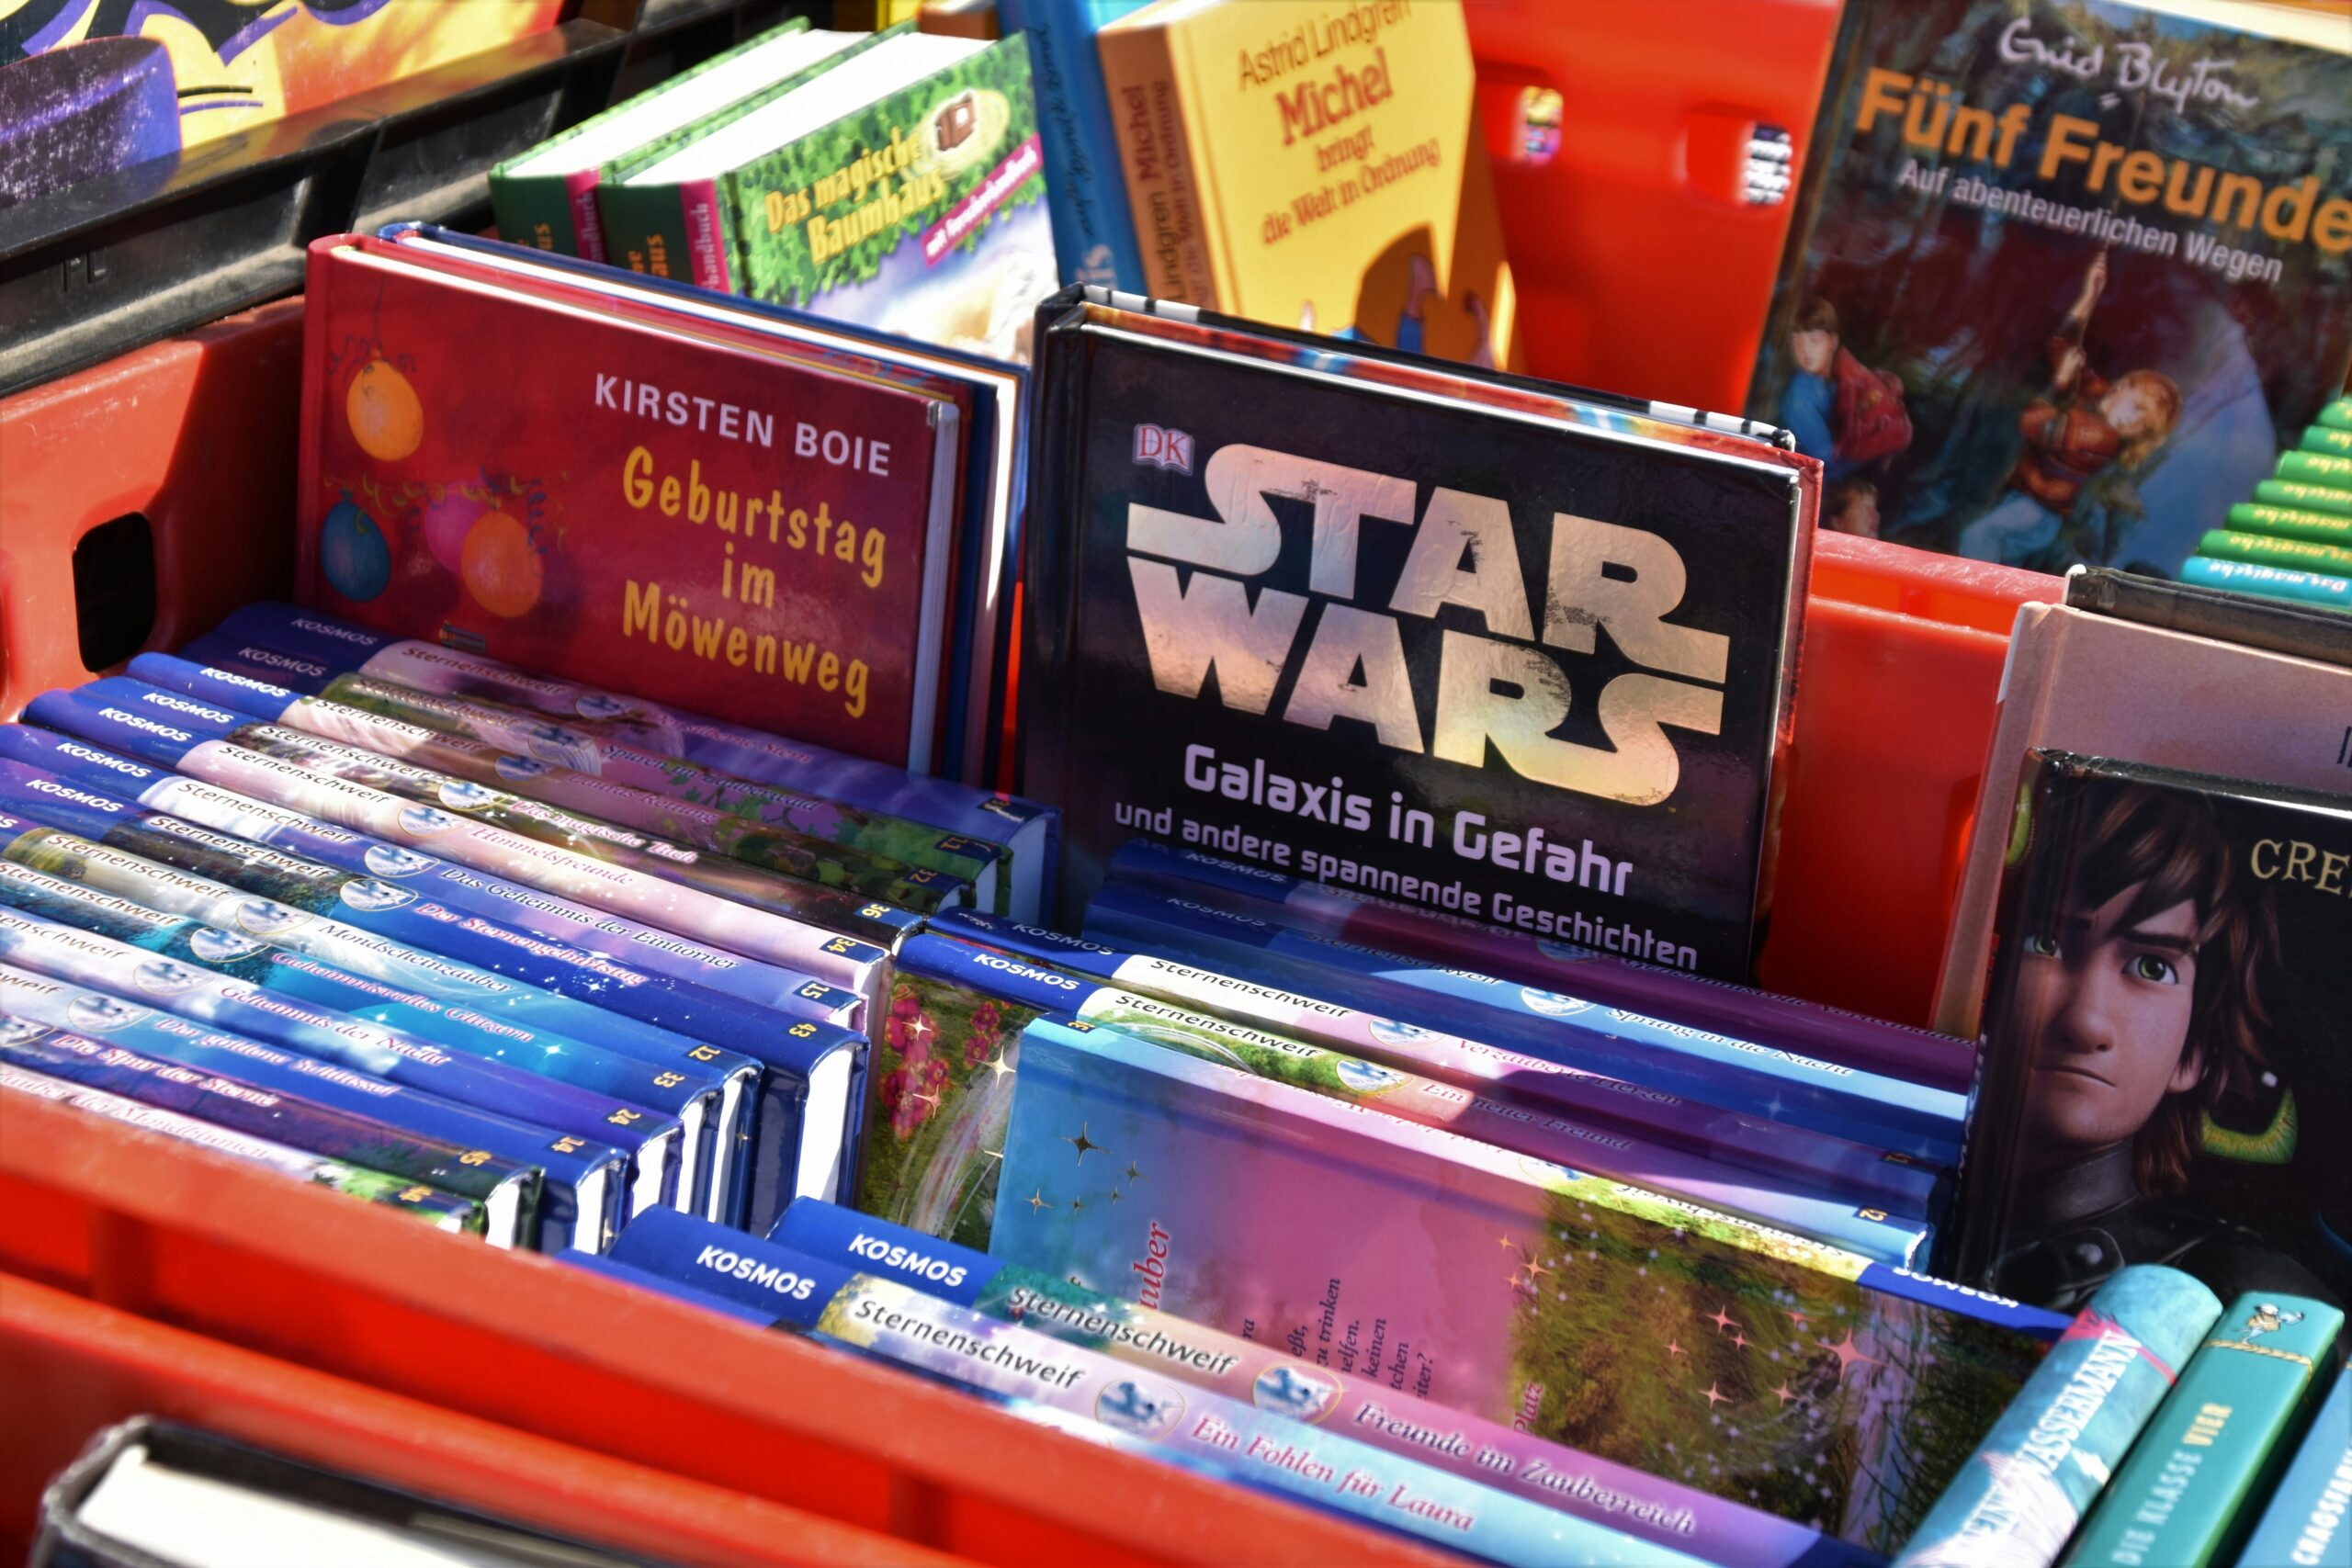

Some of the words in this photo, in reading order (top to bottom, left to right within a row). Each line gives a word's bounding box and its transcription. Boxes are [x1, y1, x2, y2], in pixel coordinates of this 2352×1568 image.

[1238, 25, 1309, 92] Astrid
[1308, 0, 1411, 57] Lindgren
[1274, 45, 1394, 147] Michel
[1999, 17, 2103, 81] Enid
[2114, 42, 2261, 113] Blyton
[764, 186, 812, 234] Das
[812, 126, 922, 209] magische
[1121, 85, 1160, 183] Michel
[1152, 80, 1180, 172] Ordnung
[1316, 124, 1375, 174] bringt
[1856, 67, 2031, 169] Fünf
[2037, 113, 2352, 255] Freunde
[806, 167, 945, 265] Baumhaus
[1150, 190, 1188, 302] Lindgren
[1261, 211, 1291, 246] die
[1291, 186, 1336, 227] Welt
[1340, 178, 1360, 208] in
[1361, 138, 1442, 195] Ordnung
[1898, 158, 1949, 197] Auf
[1951, 180, 2178, 256] abenteuerlichen
[2184, 231, 2284, 284] Wegen
[594, 372, 774, 447] KIRSTEN
[795, 422, 891, 477] BOIE
[1137, 427, 1189, 468] DK
[623, 446, 887, 589] Geburtstag
[1127, 443, 1730, 684] STAR
[2208, 560, 2305, 583] magische
[721, 541, 775, 609] im
[290, 617, 379, 647] KOSMOS
[402, 646, 568, 695] Sternenschweif
[623, 579, 869, 719] Möwenweg
[1127, 556, 1724, 807] WARS
[142, 692, 234, 724] KOSMOS
[261, 724, 434, 779] Sternenschweif
[200, 667, 290, 698] KOSMOS
[316, 698, 486, 752] Sternenschweif
[238, 646, 327, 678] KOSMOS
[601, 744, 667, 770] Spuren
[56, 741, 153, 778] KOSMOS
[176, 782, 360, 845] Sternenschweif
[439, 867, 483, 891] Das
[486, 881, 593, 926] Geheimnis
[594, 916, 634, 937] der
[633, 929, 741, 972] Einhörner
[800, 983, 831, 999] 15
[97, 706, 193, 742] KOSMOS
[219, 745, 395, 806] Sternenschweif
[469, 827, 636, 886] Himmelsfreunde
[827, 937, 857, 953] 34
[1182, 743, 1373, 832] Galaxis
[1389, 792, 1433, 849] in
[1453, 812, 1634, 897] Gefahr
[2251, 838, 2352, 897] CRE
[25, 778, 125, 815] KOSMOS
[150, 816, 338, 882] Sternenschweif
[414, 902, 457, 923] Der
[459, 915, 649, 987] Sternengeburtstag
[788, 1023, 818, 1038] 43
[861, 904, 891, 919] 36
[1114, 801, 1172, 837] und
[1182, 813, 1290, 867] andere
[1300, 848, 1483, 918] spannende
[1491, 891, 1700, 973] Geschichten
[0, 861, 186, 928] Sternenschweif
[271, 949, 442, 1014] Geheimnisvolles
[444, 1006, 535, 1043] Glitzern
[653, 1071, 685, 1089] 33
[47, 835, 236, 901] Sternenschweif
[318, 922, 514, 995] Mondscheinzauber
[688, 1044, 721, 1061] 12
[1166, 897, 1266, 927] KOSMOS
[1608, 1007, 1695, 1038] Sprung
[1699, 1030, 1726, 1045] in
[1728, 1037, 1771, 1055] die
[1771, 1048, 1853, 1077] Nacht
[0, 913, 131, 960] enschweif
[219, 985, 332, 1032] Geheimnis
[375, 1034, 453, 1067] Nacht
[607, 1108, 641, 1125] 24
[51, 1032, 100, 1055] Die
[98, 1046, 158, 1073] Spur
[153, 1019, 199, 1044] Der
[972, 953, 1080, 991] KOSMOS
[1114, 996, 1325, 1059] Sternenschweif
[1421, 1083, 1464, 1104] Ein
[1470, 1099, 1537, 1123] neuer
[1543, 1115, 1634, 1151] Freund
[1012, 923, 1117, 955] KOSMOS
[1150, 960, 1355, 1019] Sternenschweif
[1459, 1038, 1591, 1083] Verzauberte
[1593, 1076, 1682, 1105] Herzen
[1317, 1278, 1340, 1343] trinken
[1361, 1317, 1386, 1378] keinen
[695, 1244, 817, 1302] KOSMOS
[854, 1299, 1087, 1390] Sternenschweif
[1191, 1415, 1239, 1452] Ein
[1244, 1433, 1334, 1485] Fohlen
[1333, 1467, 1381, 1500] für
[1385, 1485, 1476, 1533] Laura
[848, 1233, 968, 1288] KOSMOS
[1007, 1285, 1241, 1377] Sternenschweif
[1352, 1402, 1472, 1459] Freunde
[1476, 1444, 1514, 1473] im
[1519, 1458, 1698, 1538] Zauberreich
[1513, 1382, 1544, 1433] Platz
[2111, 1528, 2155, 1566] DIE
[2136, 1450, 2202, 1526] KLASSE
[2182, 1402, 2233, 1447] VIER
